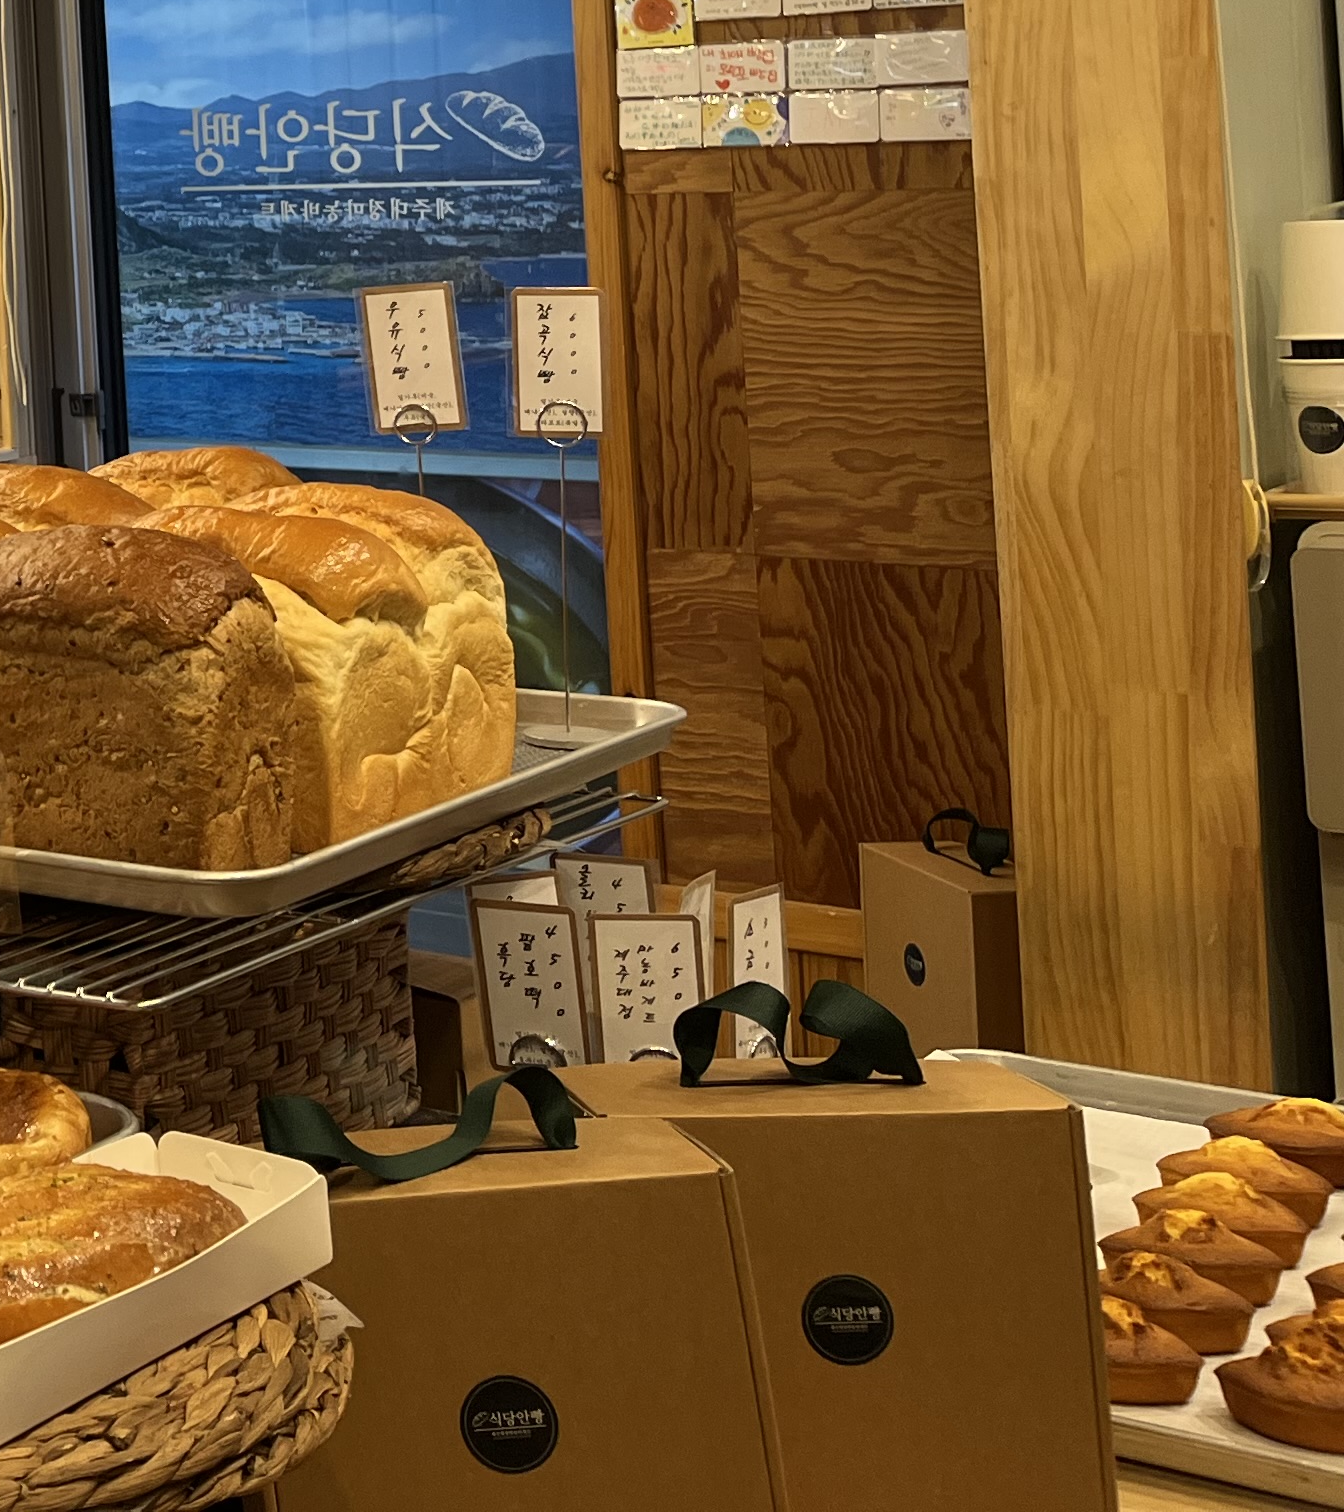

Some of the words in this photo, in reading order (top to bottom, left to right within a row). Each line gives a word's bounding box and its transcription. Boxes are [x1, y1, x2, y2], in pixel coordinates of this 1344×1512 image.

[385, 301, 410, 380] 우유식빵
[417, 308, 431, 370] 5000
[536, 303, 556, 383] 잡곡식빵
[568, 313, 578, 375] 6000
[497, 942, 516, 987] 흑당
[545, 925, 565, 1016] 4500
[614, 949, 634, 1019] 제주대정
[637, 945, 657, 1023] 마농바게트
[670, 942, 683, 1001] 650
[831, 1305, 882, 1322] 식당안빵
[489, 1408, 546, 1426] 식당안빵
